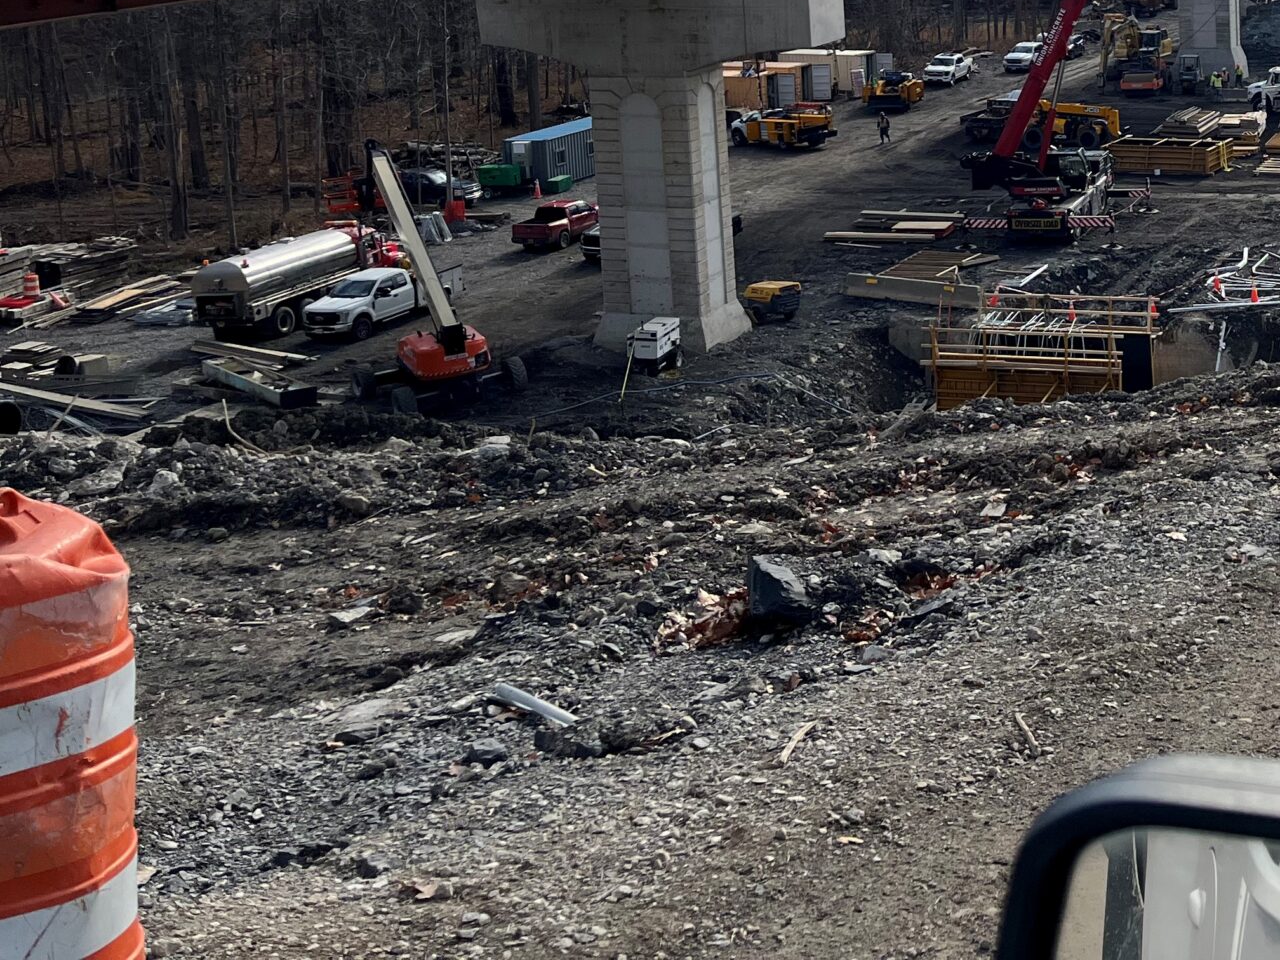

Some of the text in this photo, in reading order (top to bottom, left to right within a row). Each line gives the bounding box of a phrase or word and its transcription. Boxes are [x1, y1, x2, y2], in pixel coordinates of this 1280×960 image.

[1035, 8, 1066, 66] UNION CONCRETE
[1015, 220, 1059, 228] OVERSIZE LOAD
